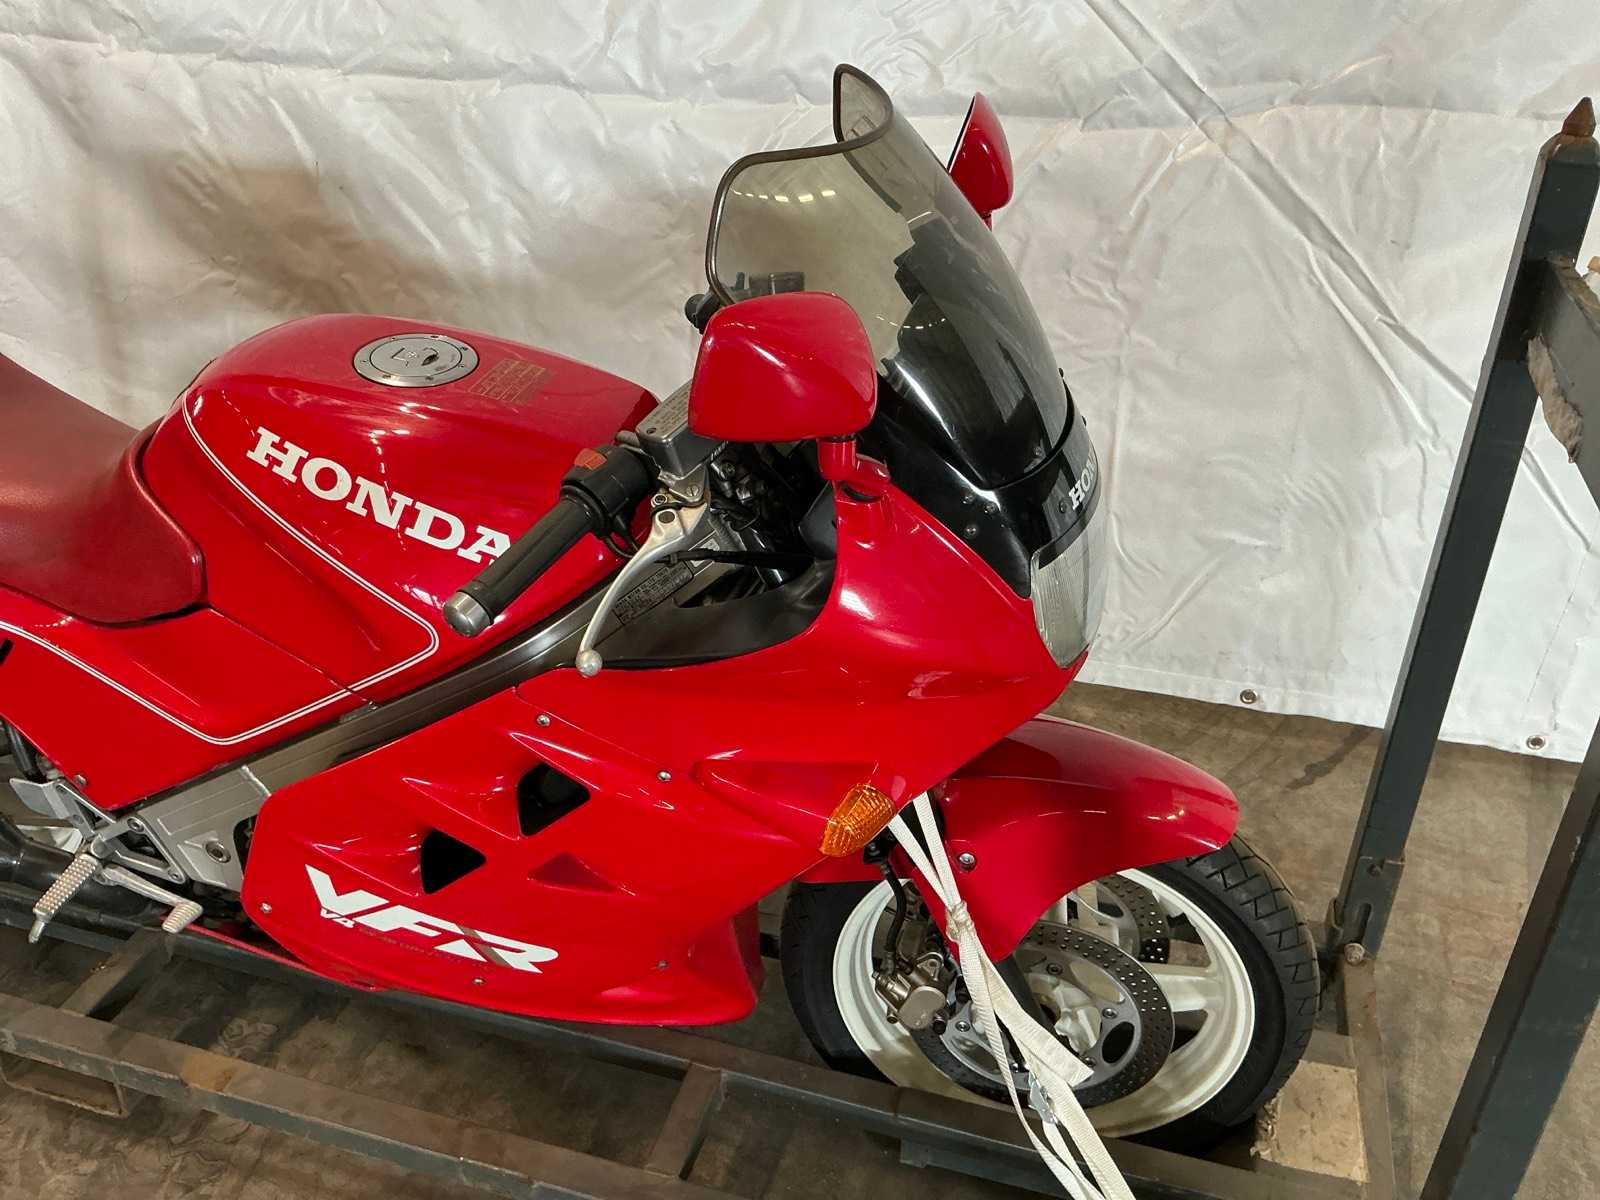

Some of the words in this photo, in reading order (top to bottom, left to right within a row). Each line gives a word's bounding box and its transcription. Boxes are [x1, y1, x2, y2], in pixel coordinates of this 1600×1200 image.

[246, 426, 511, 565] HONDA
[305, 864, 559, 974] VFR
[320, 907, 355, 928] V4
